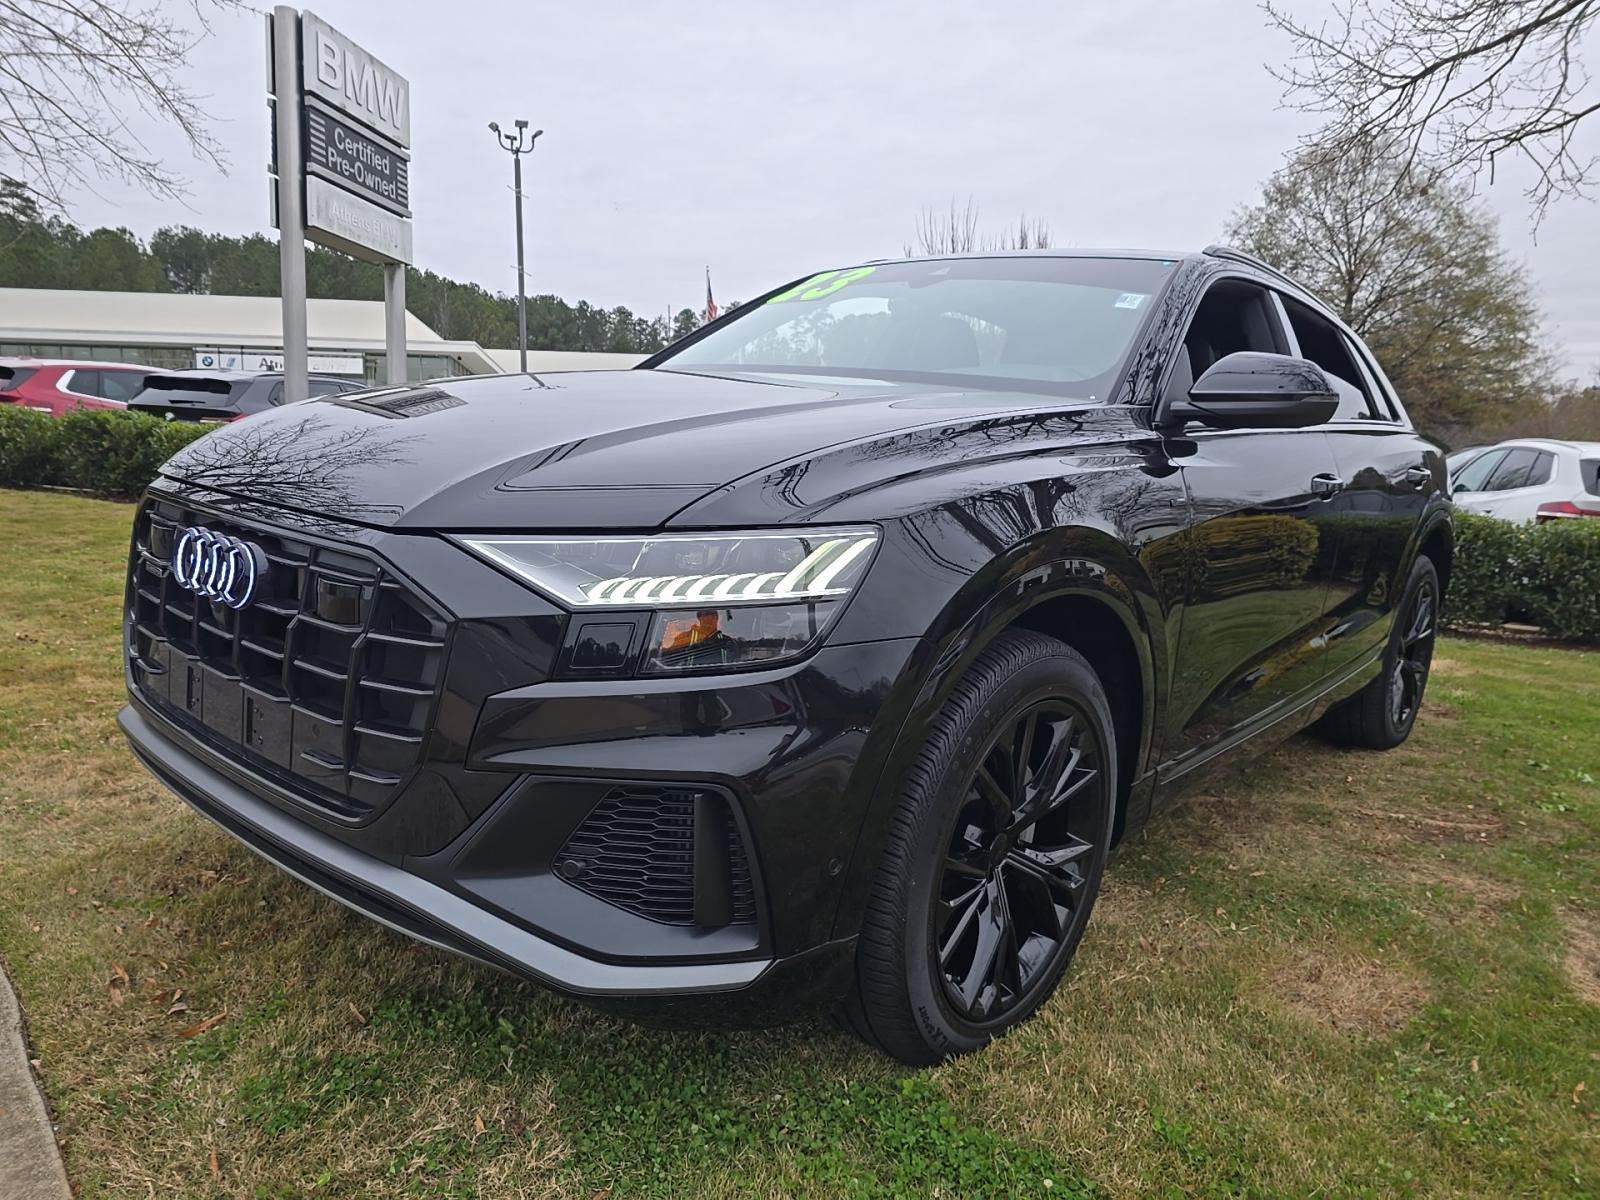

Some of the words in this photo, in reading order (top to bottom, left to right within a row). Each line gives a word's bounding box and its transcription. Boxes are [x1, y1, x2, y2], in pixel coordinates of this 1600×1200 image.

[317, 30, 404, 129] BMW
[327, 146, 396, 200] Pre-Owned
[334, 127, 390, 175] Certified
